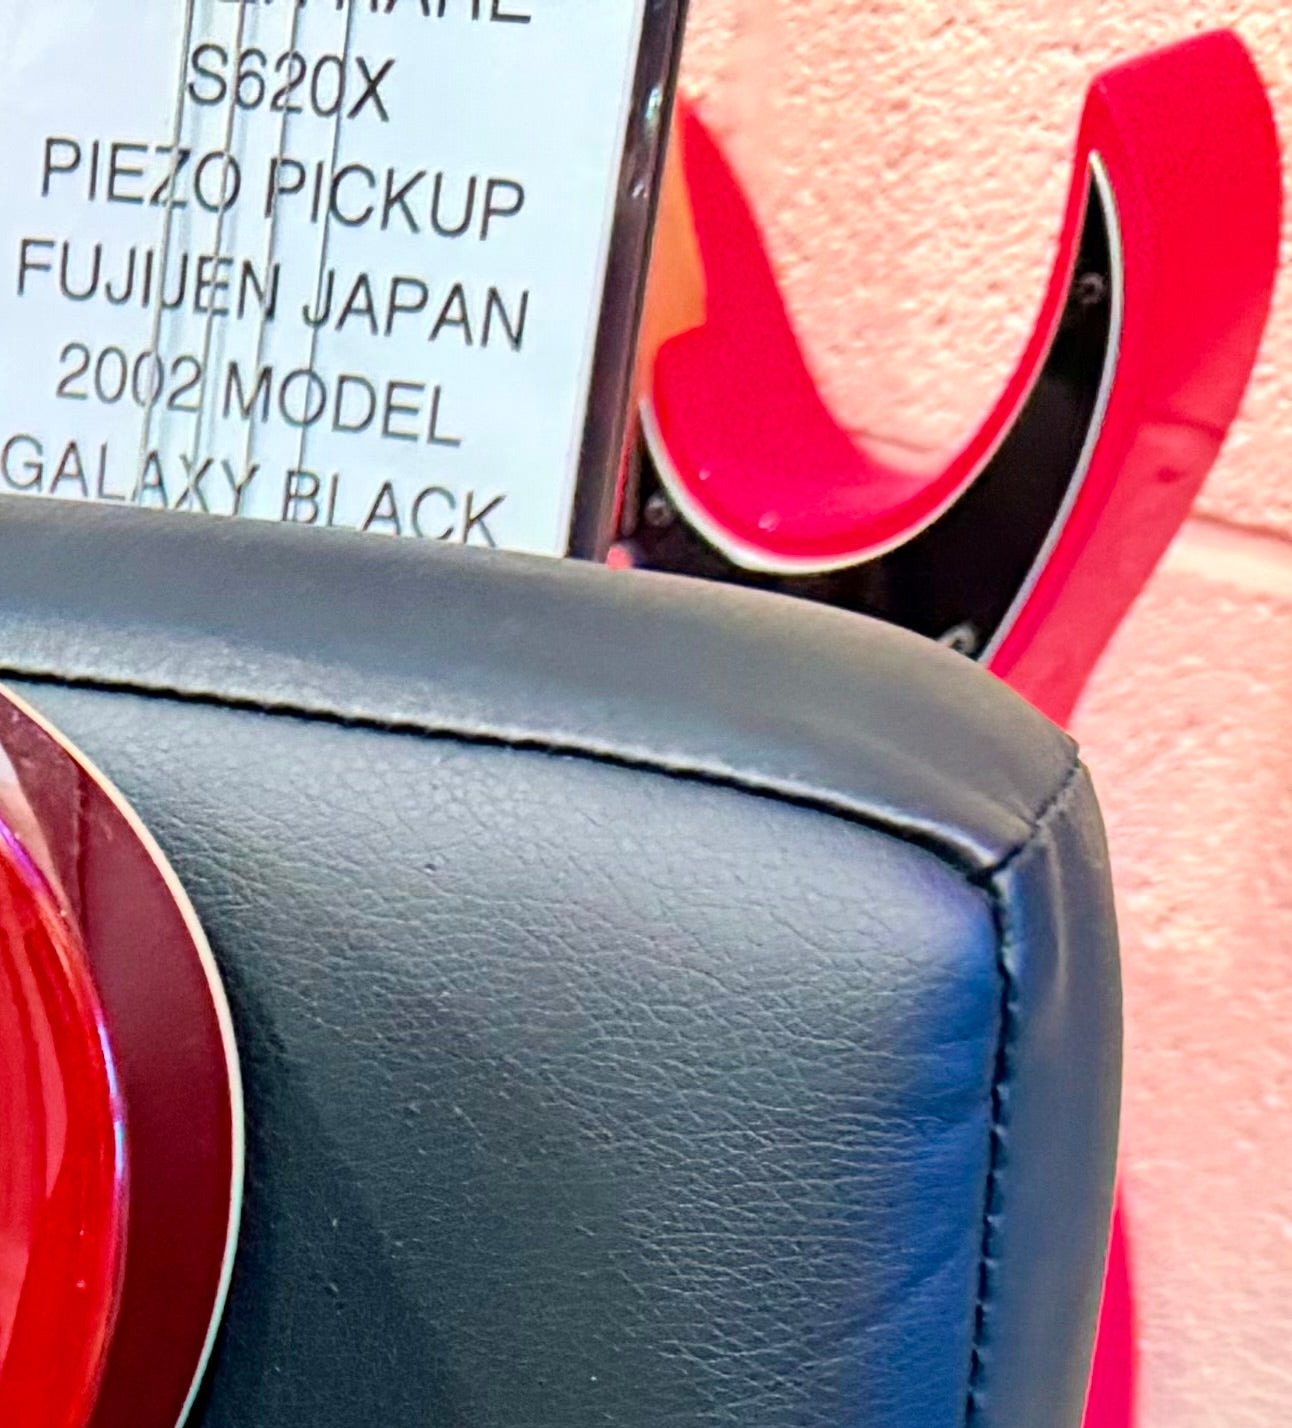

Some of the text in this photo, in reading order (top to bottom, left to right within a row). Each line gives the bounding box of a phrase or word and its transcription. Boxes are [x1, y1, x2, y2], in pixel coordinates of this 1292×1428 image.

[188, 43, 396, 122] S620X
[41, 137, 526, 240] PIEZO PICKUP
[302, 268, 530, 352] JAPAN
[55, 342, 462, 448] 2002 MODEL
[0, 433, 507, 548] GALAXY BLACK
